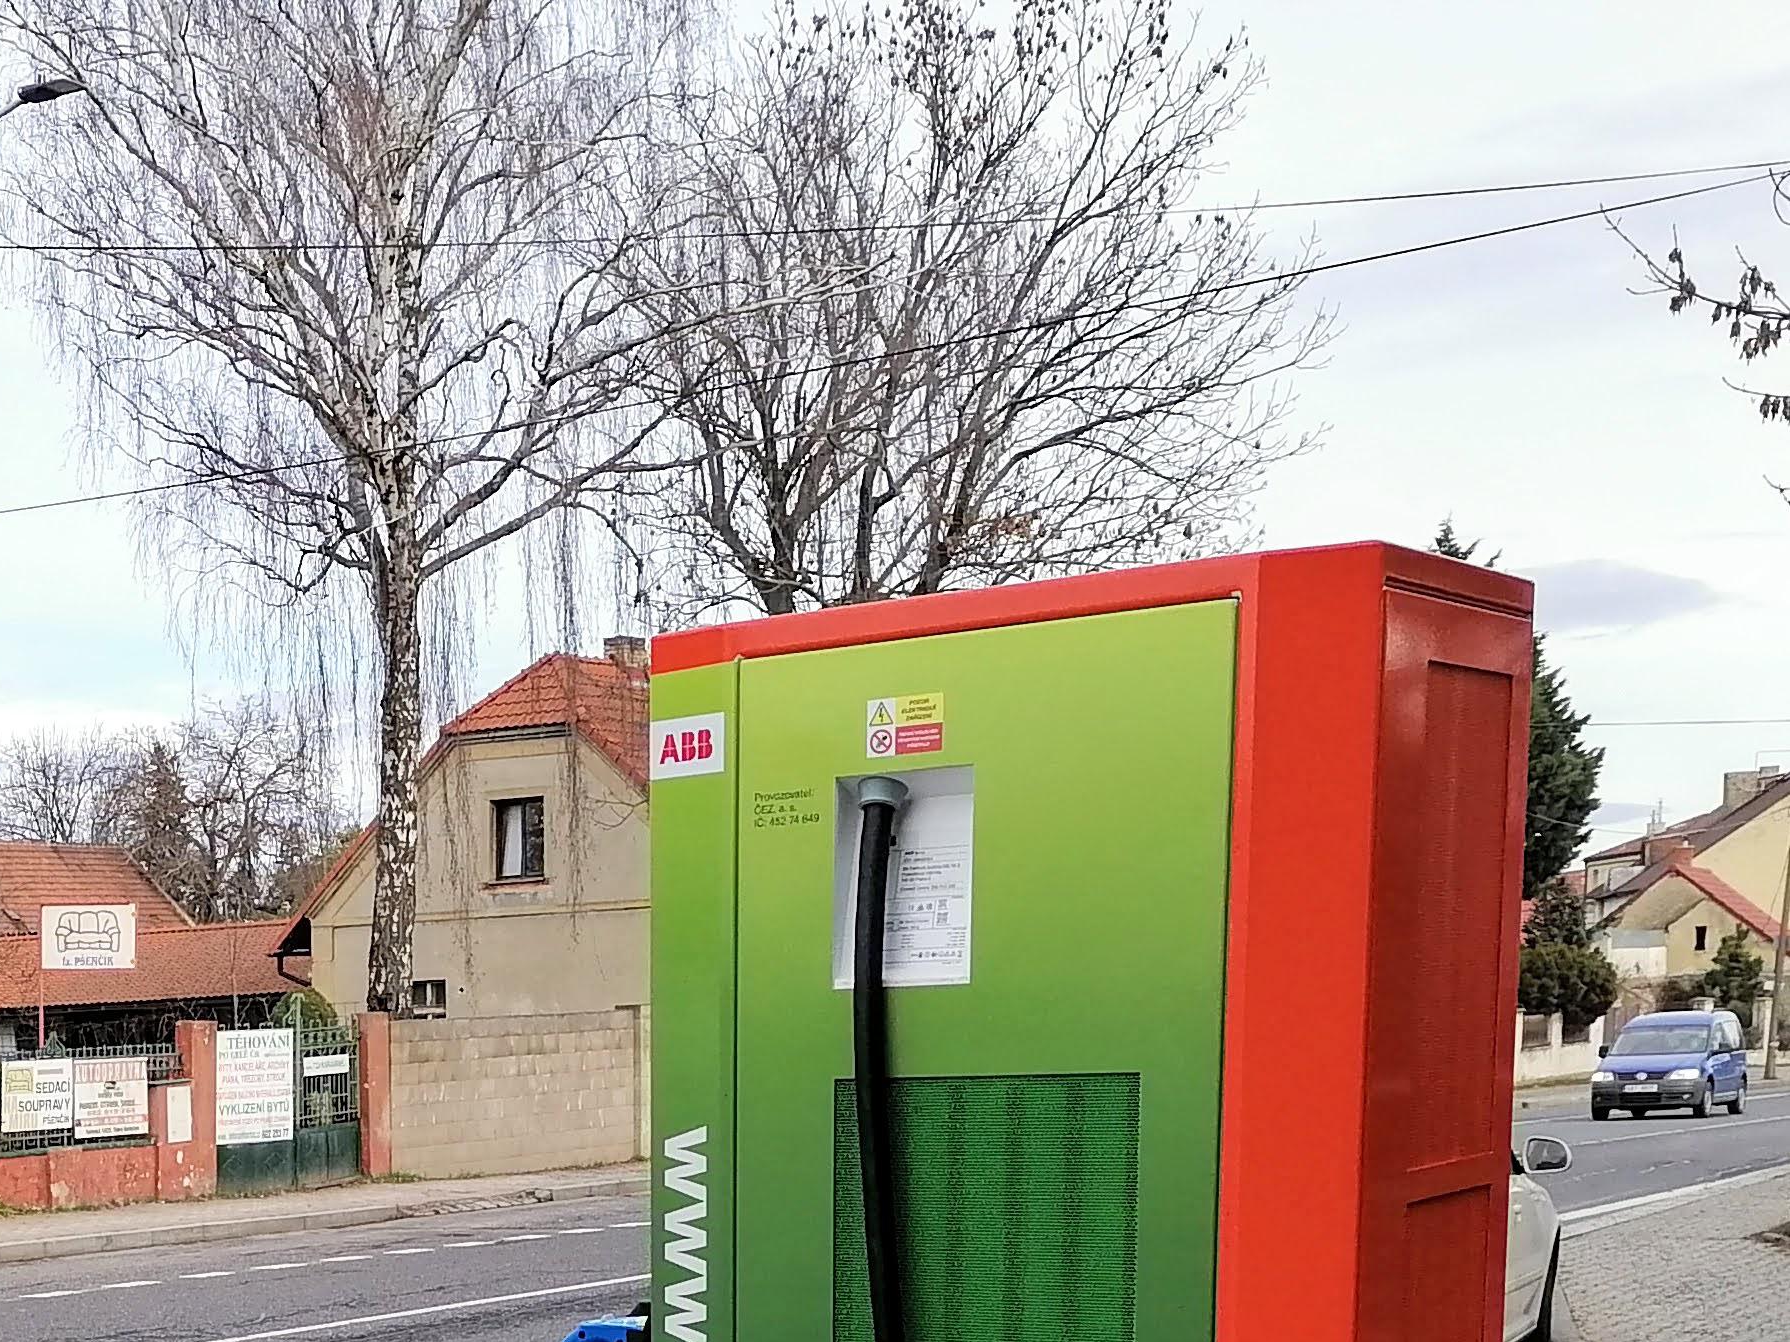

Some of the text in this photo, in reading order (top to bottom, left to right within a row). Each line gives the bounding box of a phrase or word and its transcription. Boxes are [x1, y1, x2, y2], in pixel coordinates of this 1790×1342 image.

[659, 729, 713, 765] ABB
[36, 1078, 71, 1094] SEDACÍ
[18, 1098, 71, 1112] SOUPRAVY
